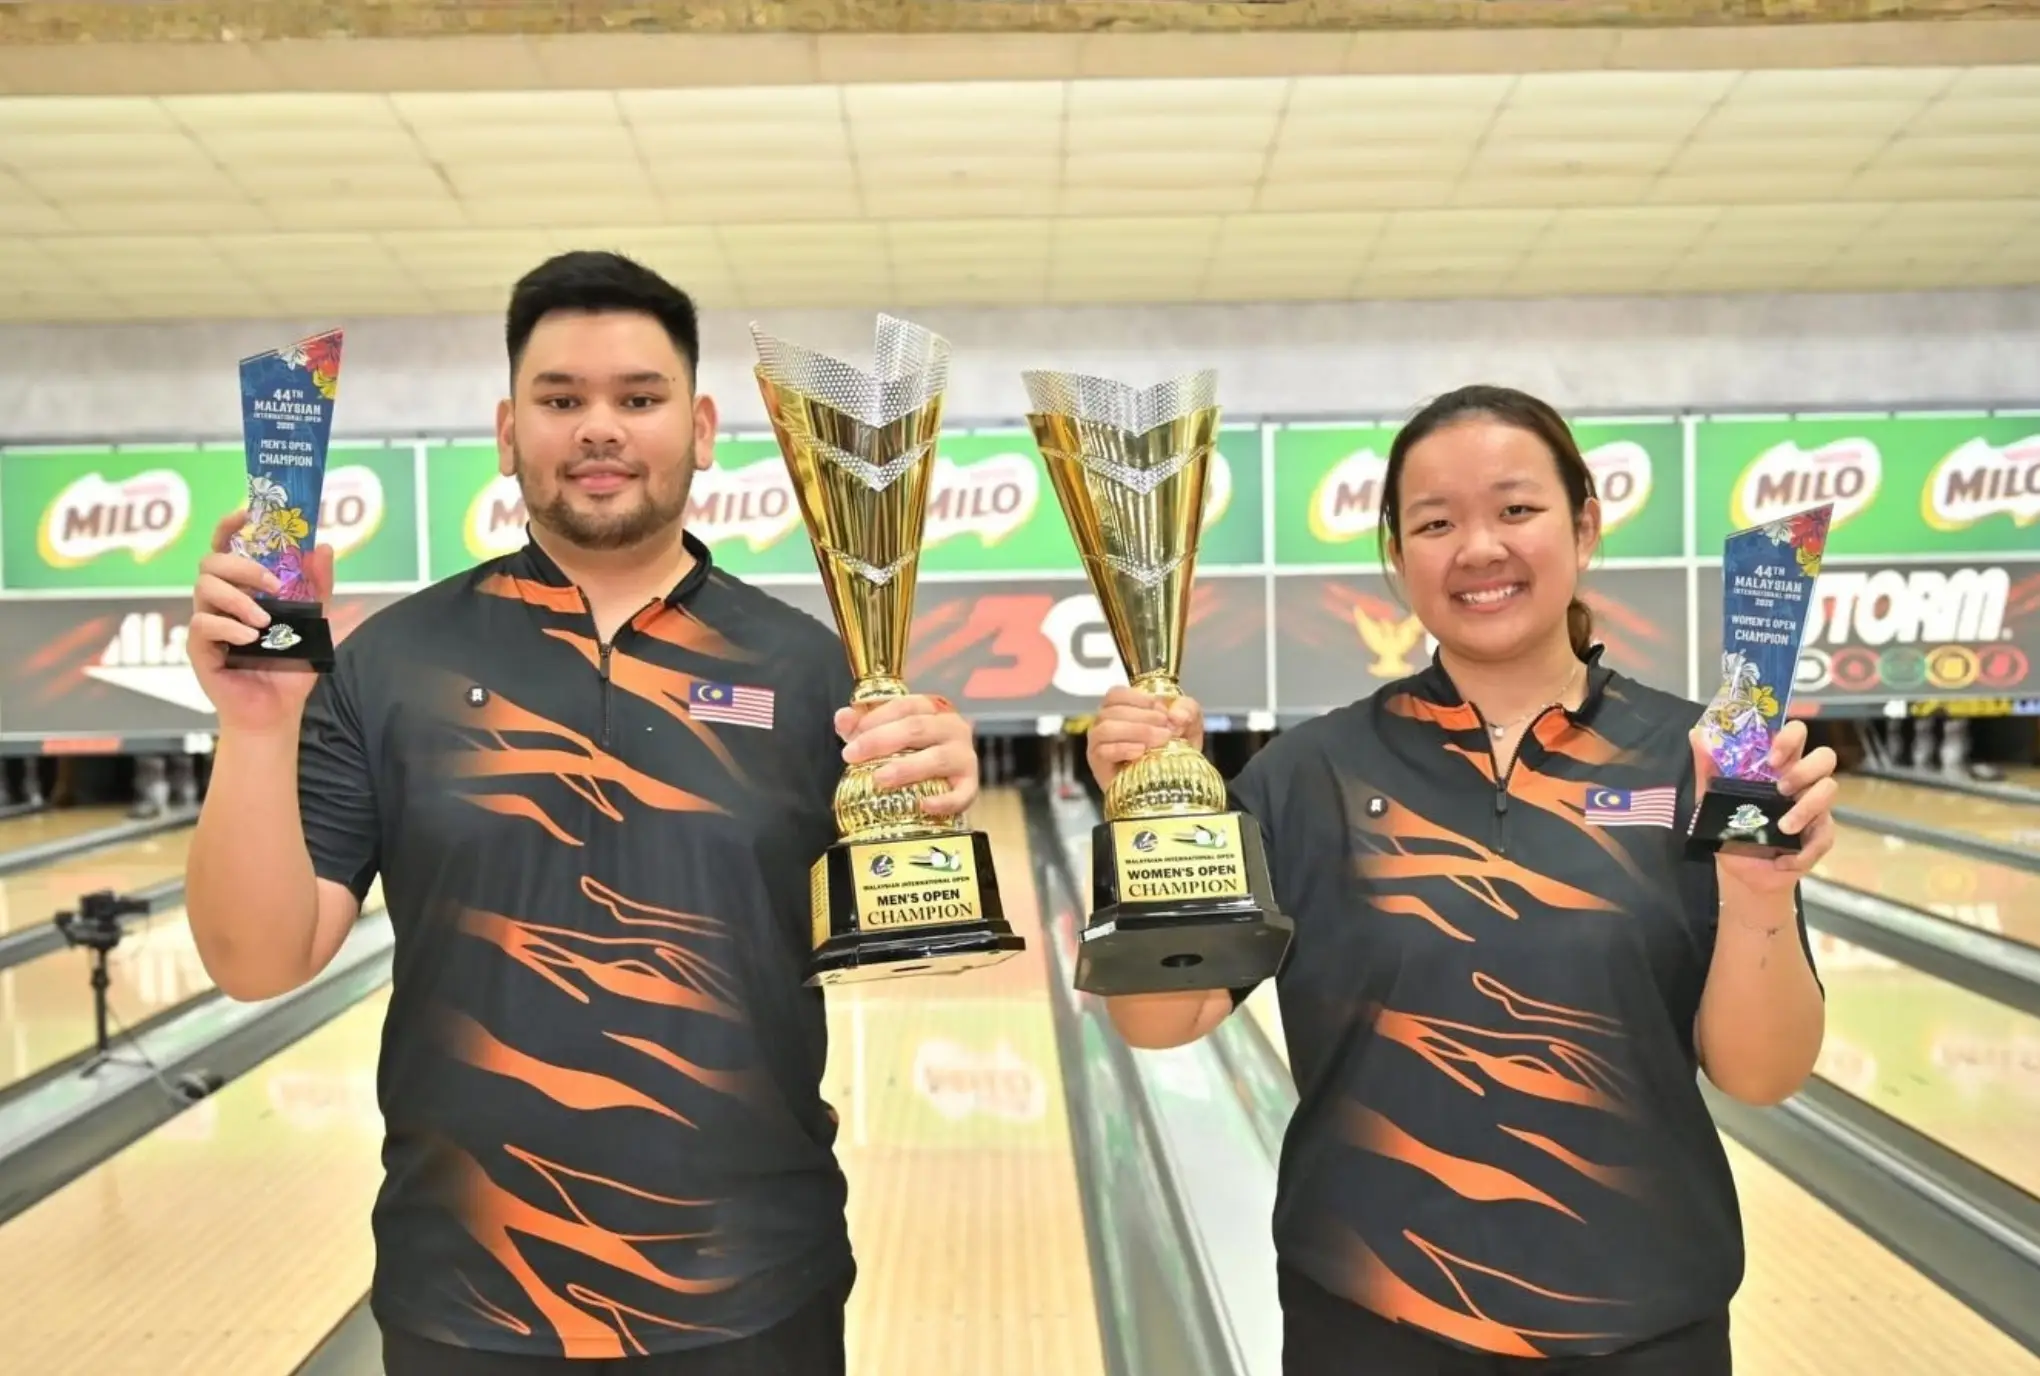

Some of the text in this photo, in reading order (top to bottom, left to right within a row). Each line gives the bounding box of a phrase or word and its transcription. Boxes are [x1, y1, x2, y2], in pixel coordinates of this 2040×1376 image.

[273, 388, 304, 401] 44TH
[254, 400, 321, 415] MALAYSIAN
[261, 438, 312, 452] MEN'S OPEN
[259, 453, 313, 467] CHAMPION
[1755, 466, 1865, 509] MILO
[63, 499, 174, 542] MILO
[1754, 564, 1785, 577] 44TH
[1734, 576, 1802, 592] MALAYSIAN
[1731, 615, 1796, 630] WOMEN'S OPEN
[1734, 629, 1789, 646] CHAMPION
[1127, 864, 1236, 880] WOMEN'S OPEN
[863, 882, 900, 891] MALAYSIAN
[1128, 879, 1238, 897] CHAMPION
[877, 888, 960, 907] MEN'S OPEN
[867, 902, 973, 925] CHAMPION
